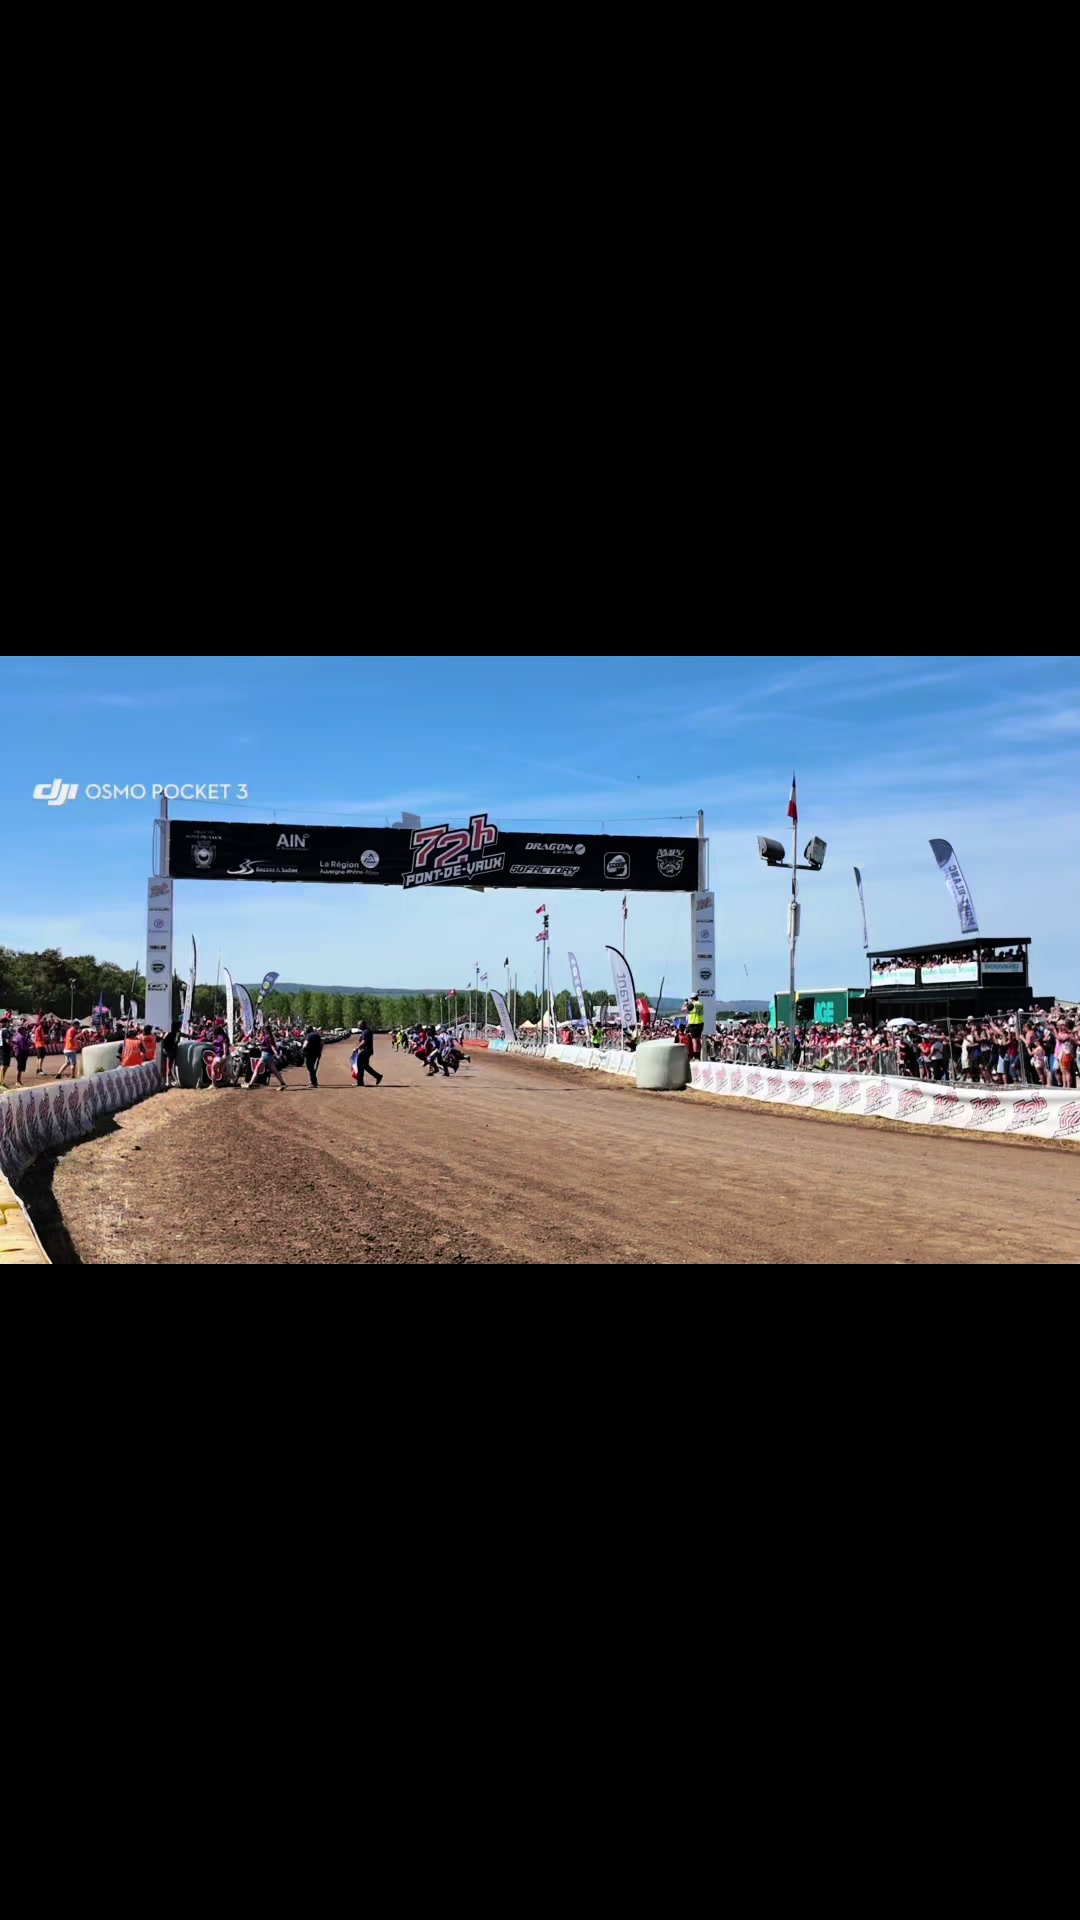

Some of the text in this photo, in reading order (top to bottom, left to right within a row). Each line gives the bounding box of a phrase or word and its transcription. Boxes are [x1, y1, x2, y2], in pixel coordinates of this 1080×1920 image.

[276, 833, 306, 848] AIN
[413, 816, 496, 869] 72h
[525, 842, 574, 851] DRAGON
[331, 860, 360, 871] Région
[405, 857, 503, 887] PONT-DE-VAUX
